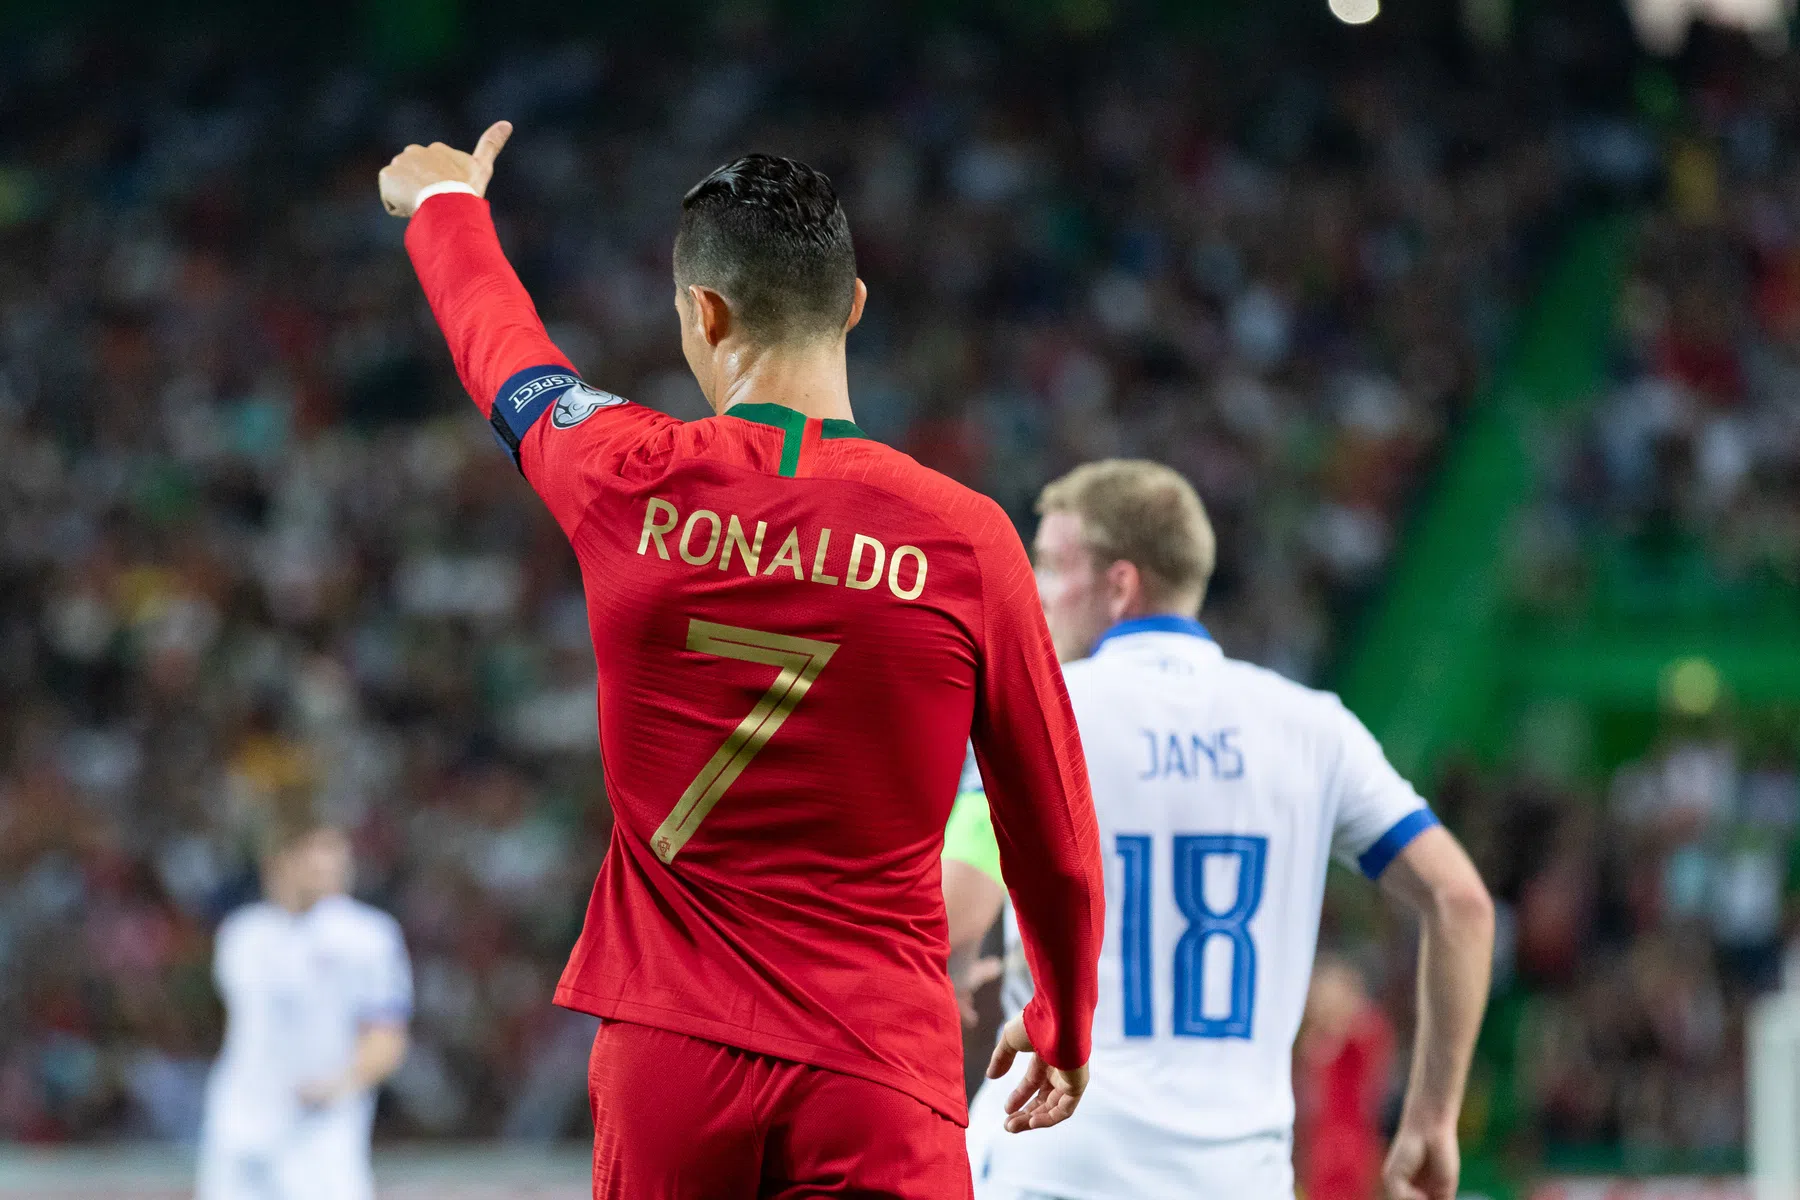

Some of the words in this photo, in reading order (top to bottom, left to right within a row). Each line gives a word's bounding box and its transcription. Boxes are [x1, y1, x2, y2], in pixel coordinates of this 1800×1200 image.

[513, 376, 578, 410] ESPECT
[637, 497, 928, 600] RONALDO
[650, 618, 841, 865] 7
[1138, 727, 1244, 781] JANS
[1115, 834, 1268, 1039] 18
